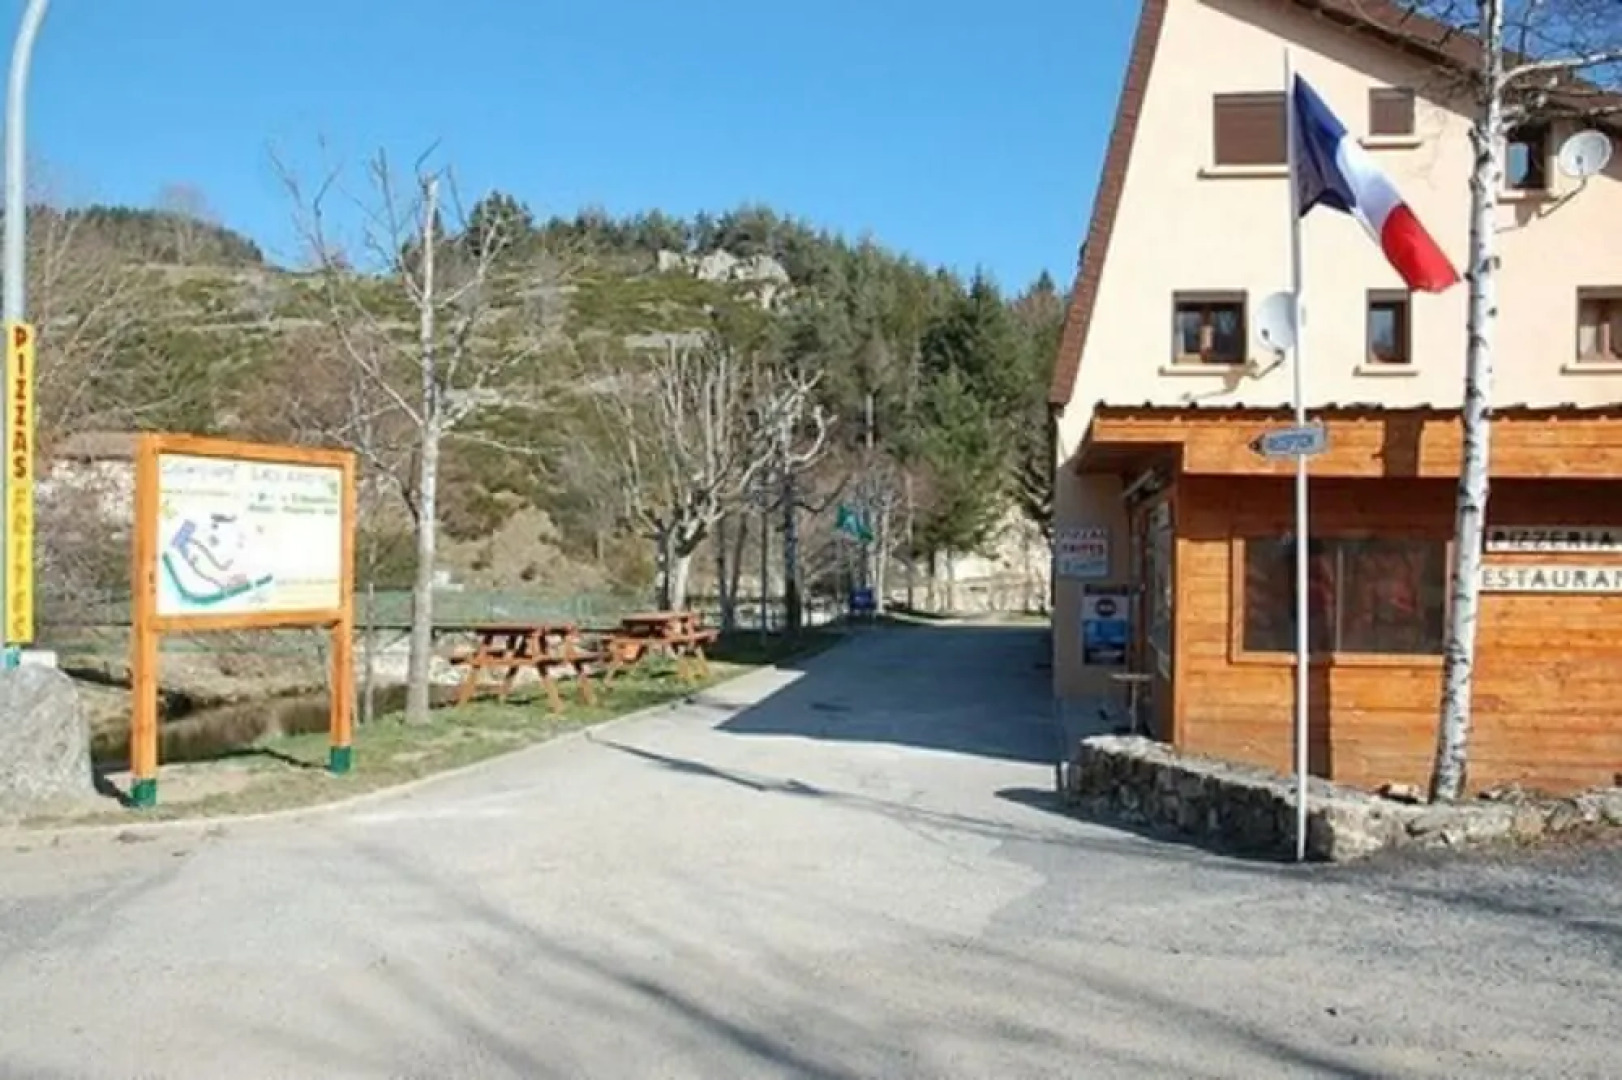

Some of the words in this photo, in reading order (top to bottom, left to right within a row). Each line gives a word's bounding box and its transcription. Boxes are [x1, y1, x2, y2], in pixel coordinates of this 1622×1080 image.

[13, 325, 28, 479] PIZZAS
[1492, 531, 1614, 549] PIZZERIA
[1482, 570, 1622, 589] ESTAURA
